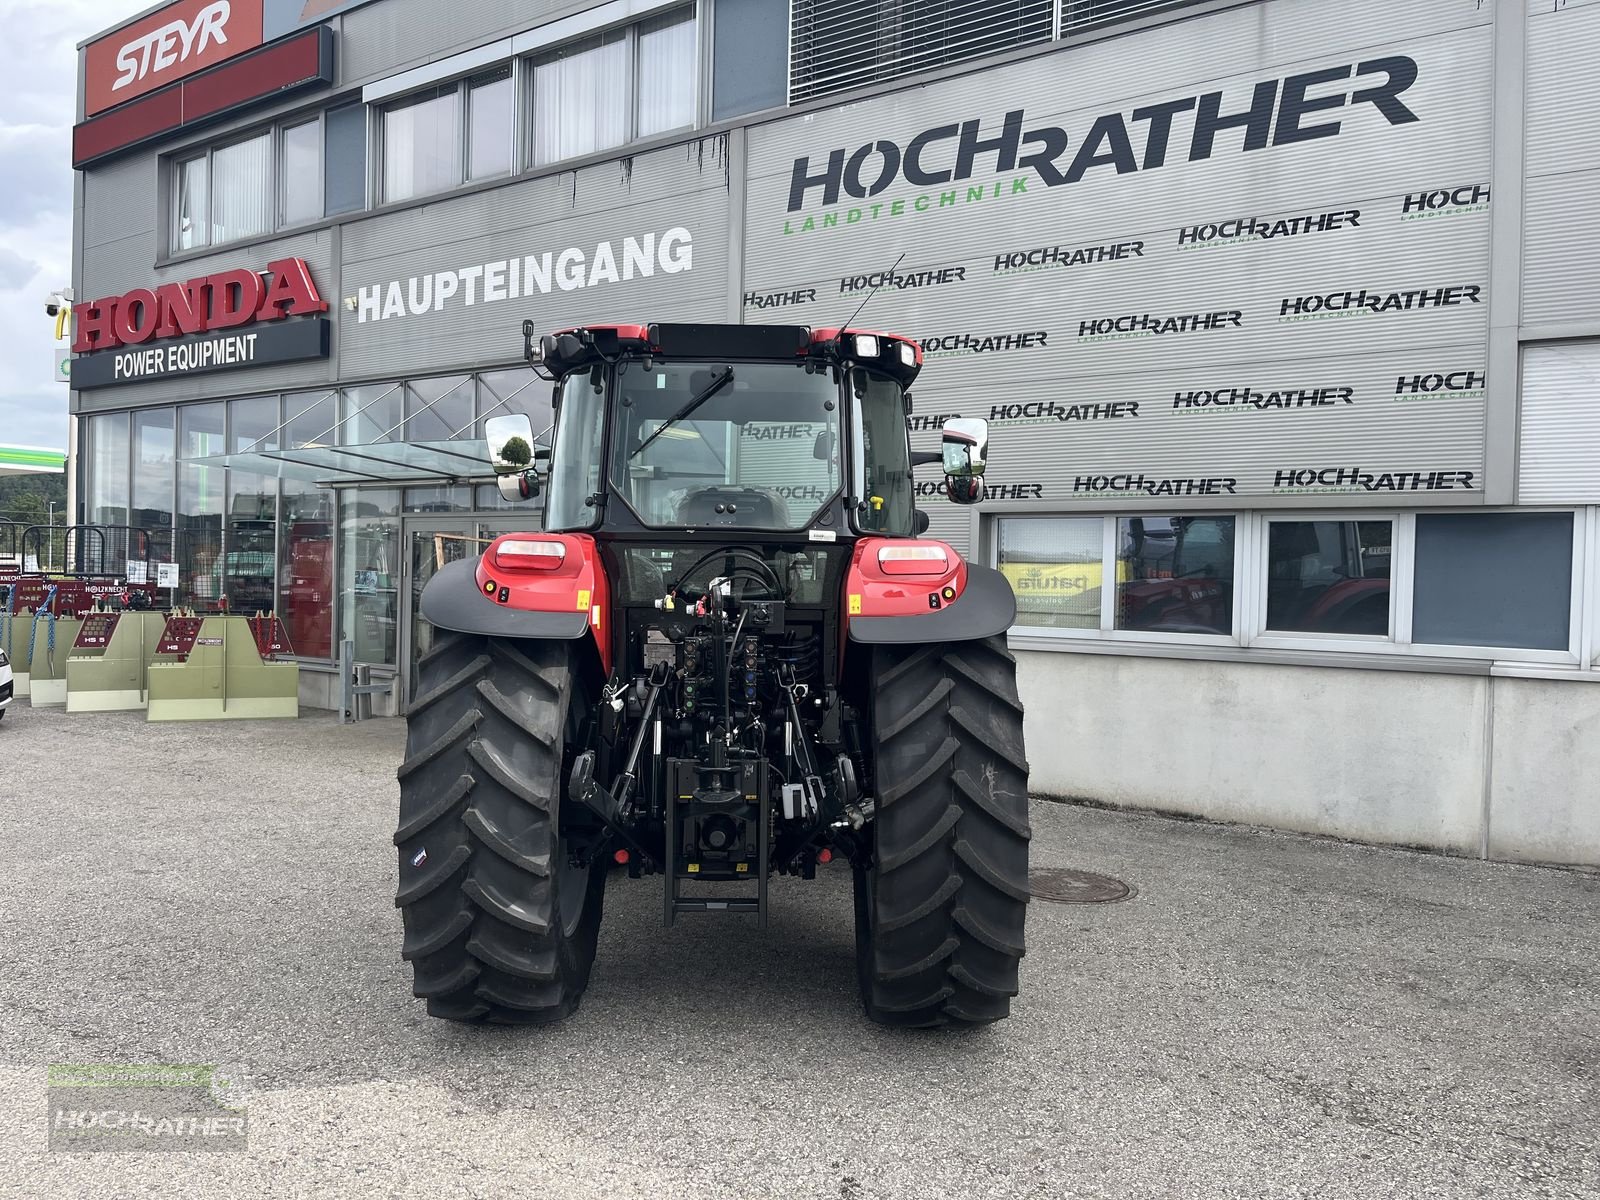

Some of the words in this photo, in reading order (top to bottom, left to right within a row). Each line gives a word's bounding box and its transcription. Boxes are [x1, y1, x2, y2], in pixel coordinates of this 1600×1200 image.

[111, 0, 232, 92] STEYR
[787, 55, 1420, 213] HOCHRATHER
[783, 176, 1030, 235] LANDTECHNIK
[1402, 185, 1490, 213] HOCH
[1178, 209, 1361, 245] HOCHRATHER
[993, 240, 1144, 271] HOCHRATHER
[1177, 233, 1260, 252] LANDTECHNIK
[357, 226, 694, 324] HAUPTEINGANG
[839, 266, 966, 293] HOCHRATHER
[71, 257, 328, 353] HONDA
[1279, 284, 1481, 316] HOCHRATHER
[1078, 310, 1243, 336] HOCHRATHER
[115, 348, 165, 379] POWER
[168, 333, 258, 372] EQUIPMENT
[1395, 371, 1485, 394] HOCH
[990, 401, 1140, 422] HOCHRATHER
[1172, 387, 1355, 410] HOCHRATHER
[1073, 474, 1237, 496] HOCHRATHER
[1273, 467, 1474, 491] HOCHRATHER
